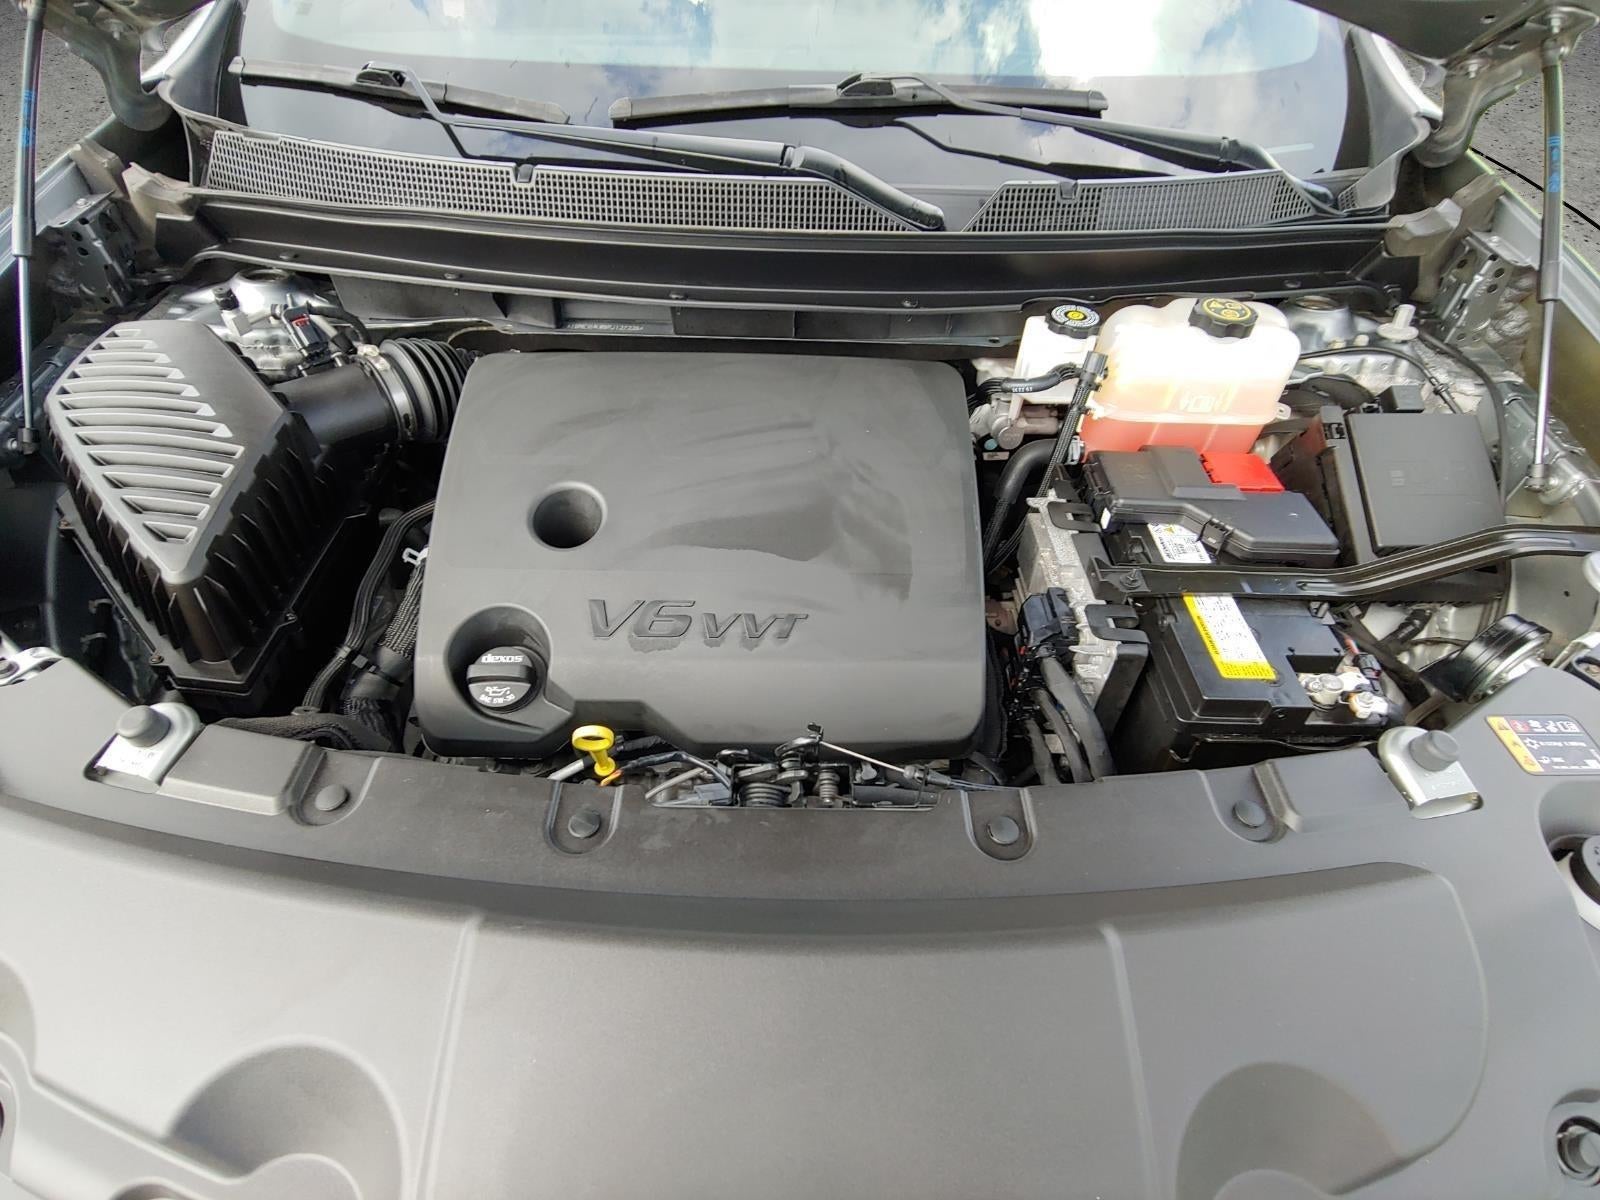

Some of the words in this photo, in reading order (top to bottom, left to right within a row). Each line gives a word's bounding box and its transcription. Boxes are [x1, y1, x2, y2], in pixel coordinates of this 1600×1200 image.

[588, 599, 696, 638] V6
[702, 613, 809, 639] VVT
[481, 653, 524, 663] dexos
